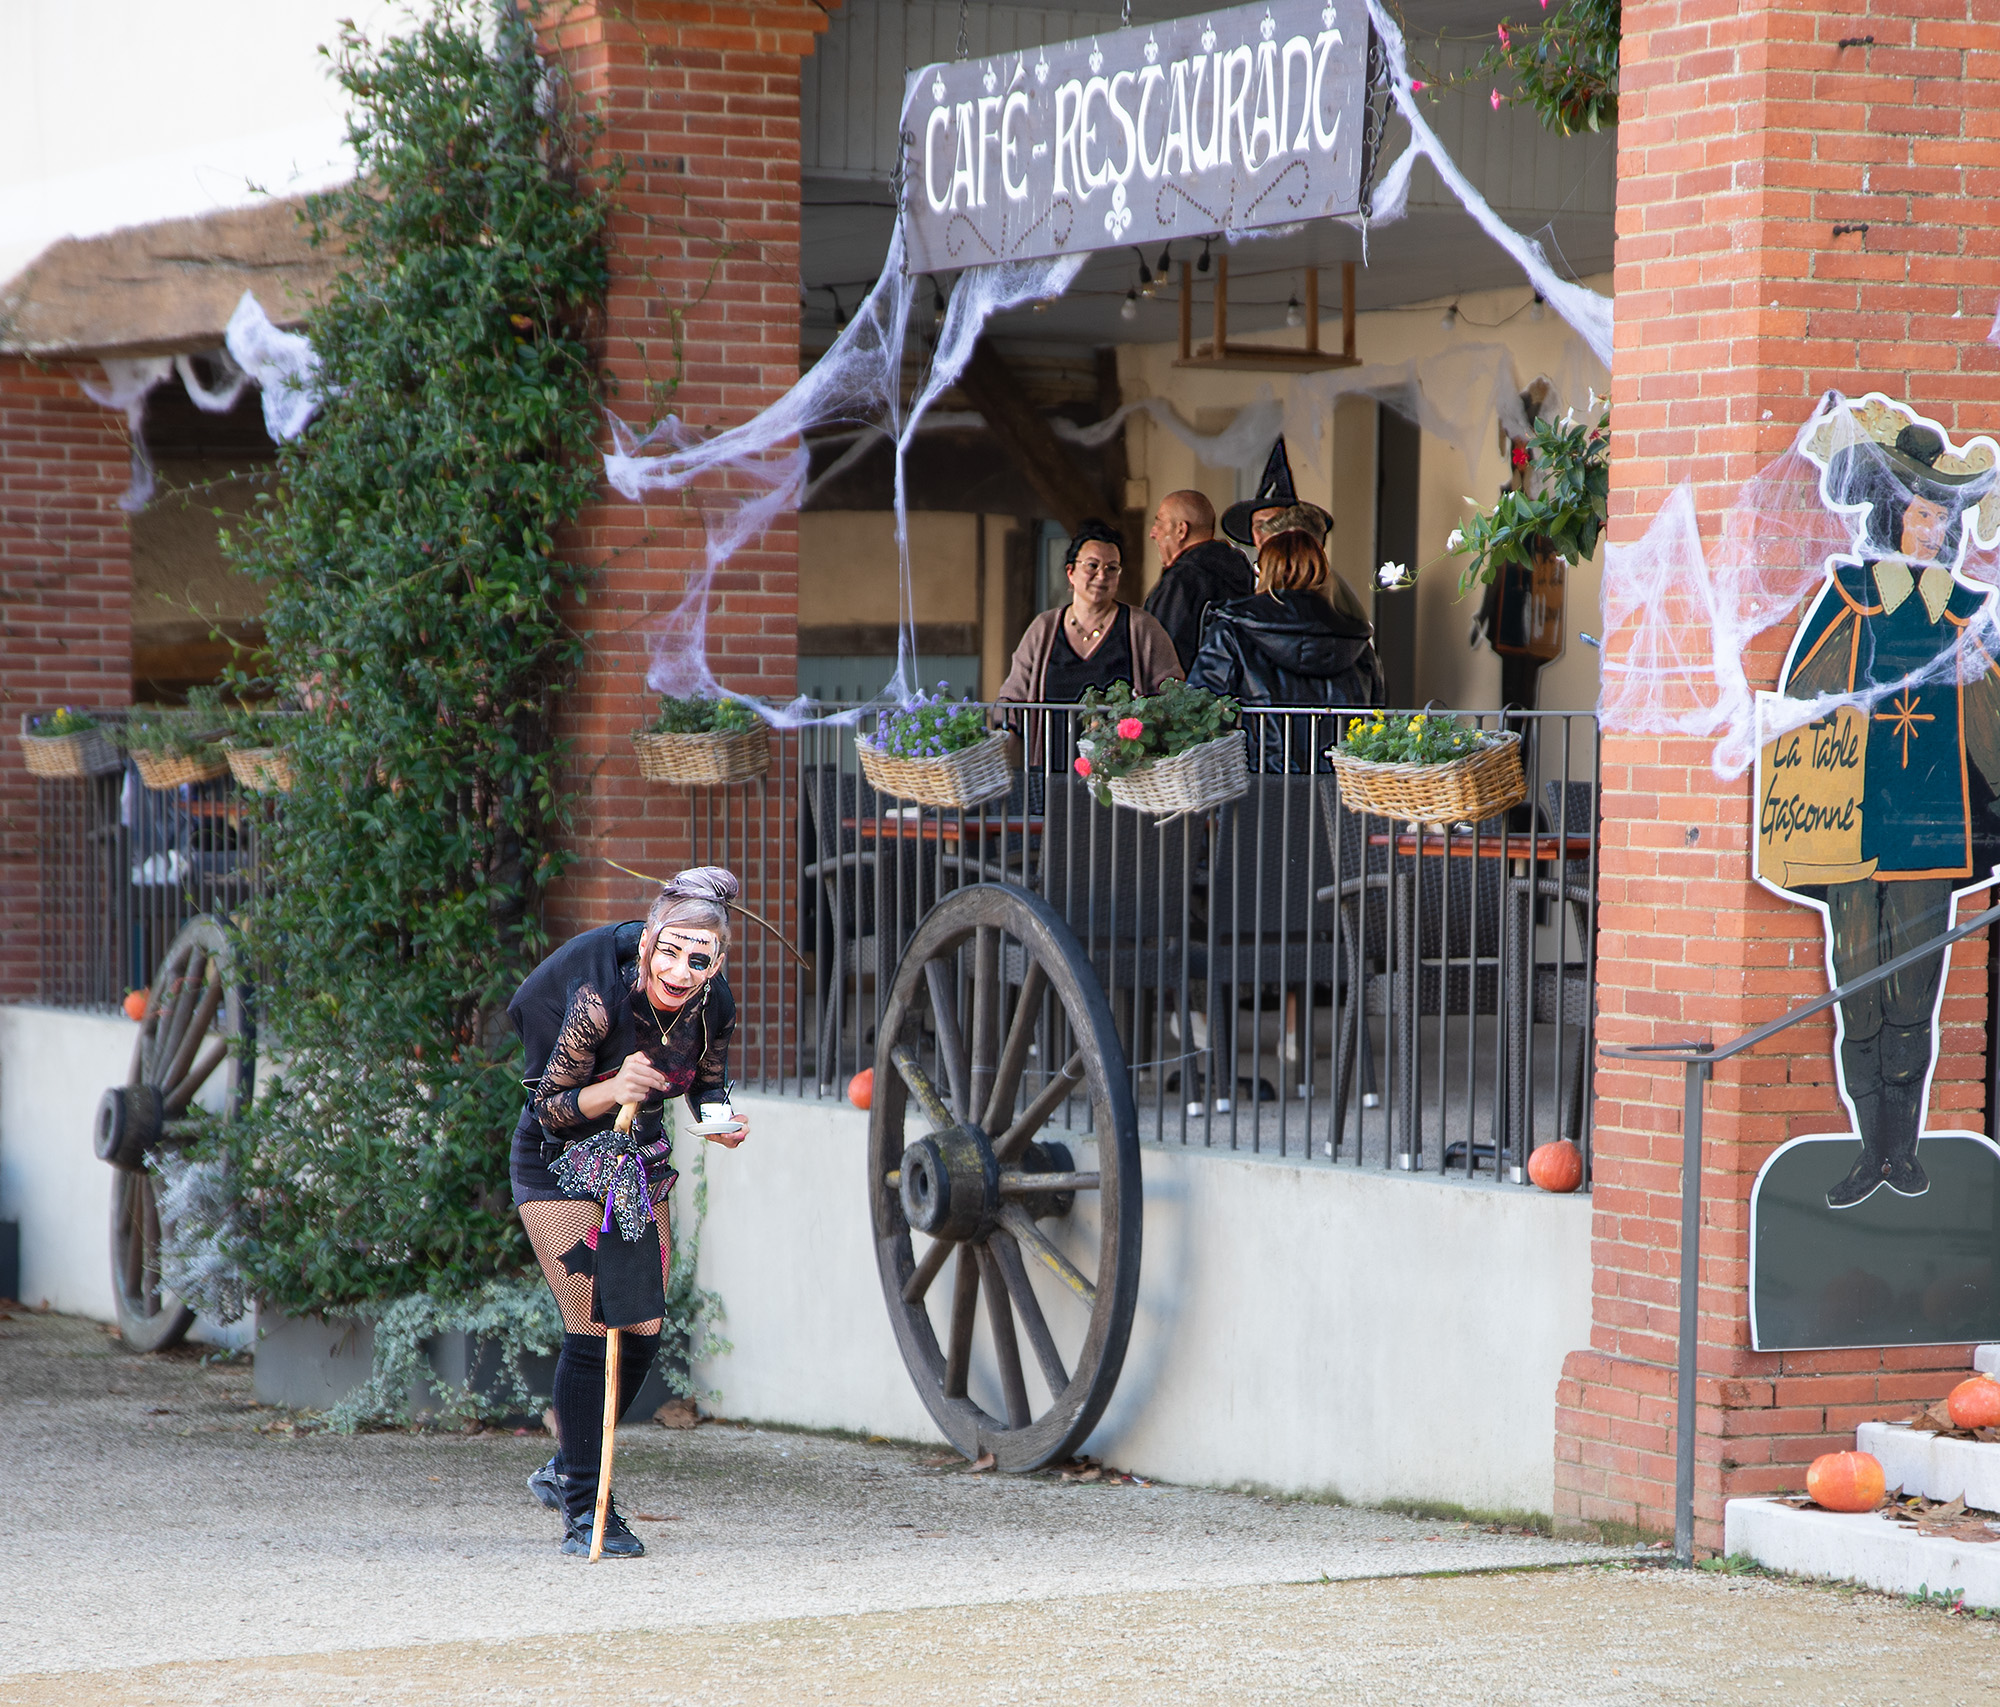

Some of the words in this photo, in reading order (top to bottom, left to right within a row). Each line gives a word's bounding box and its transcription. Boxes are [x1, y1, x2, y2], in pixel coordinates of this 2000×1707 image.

[1774, 736, 1802, 768] La
[1809, 715, 1859, 772] Table
[1761, 773, 1855, 845] Gasconne
